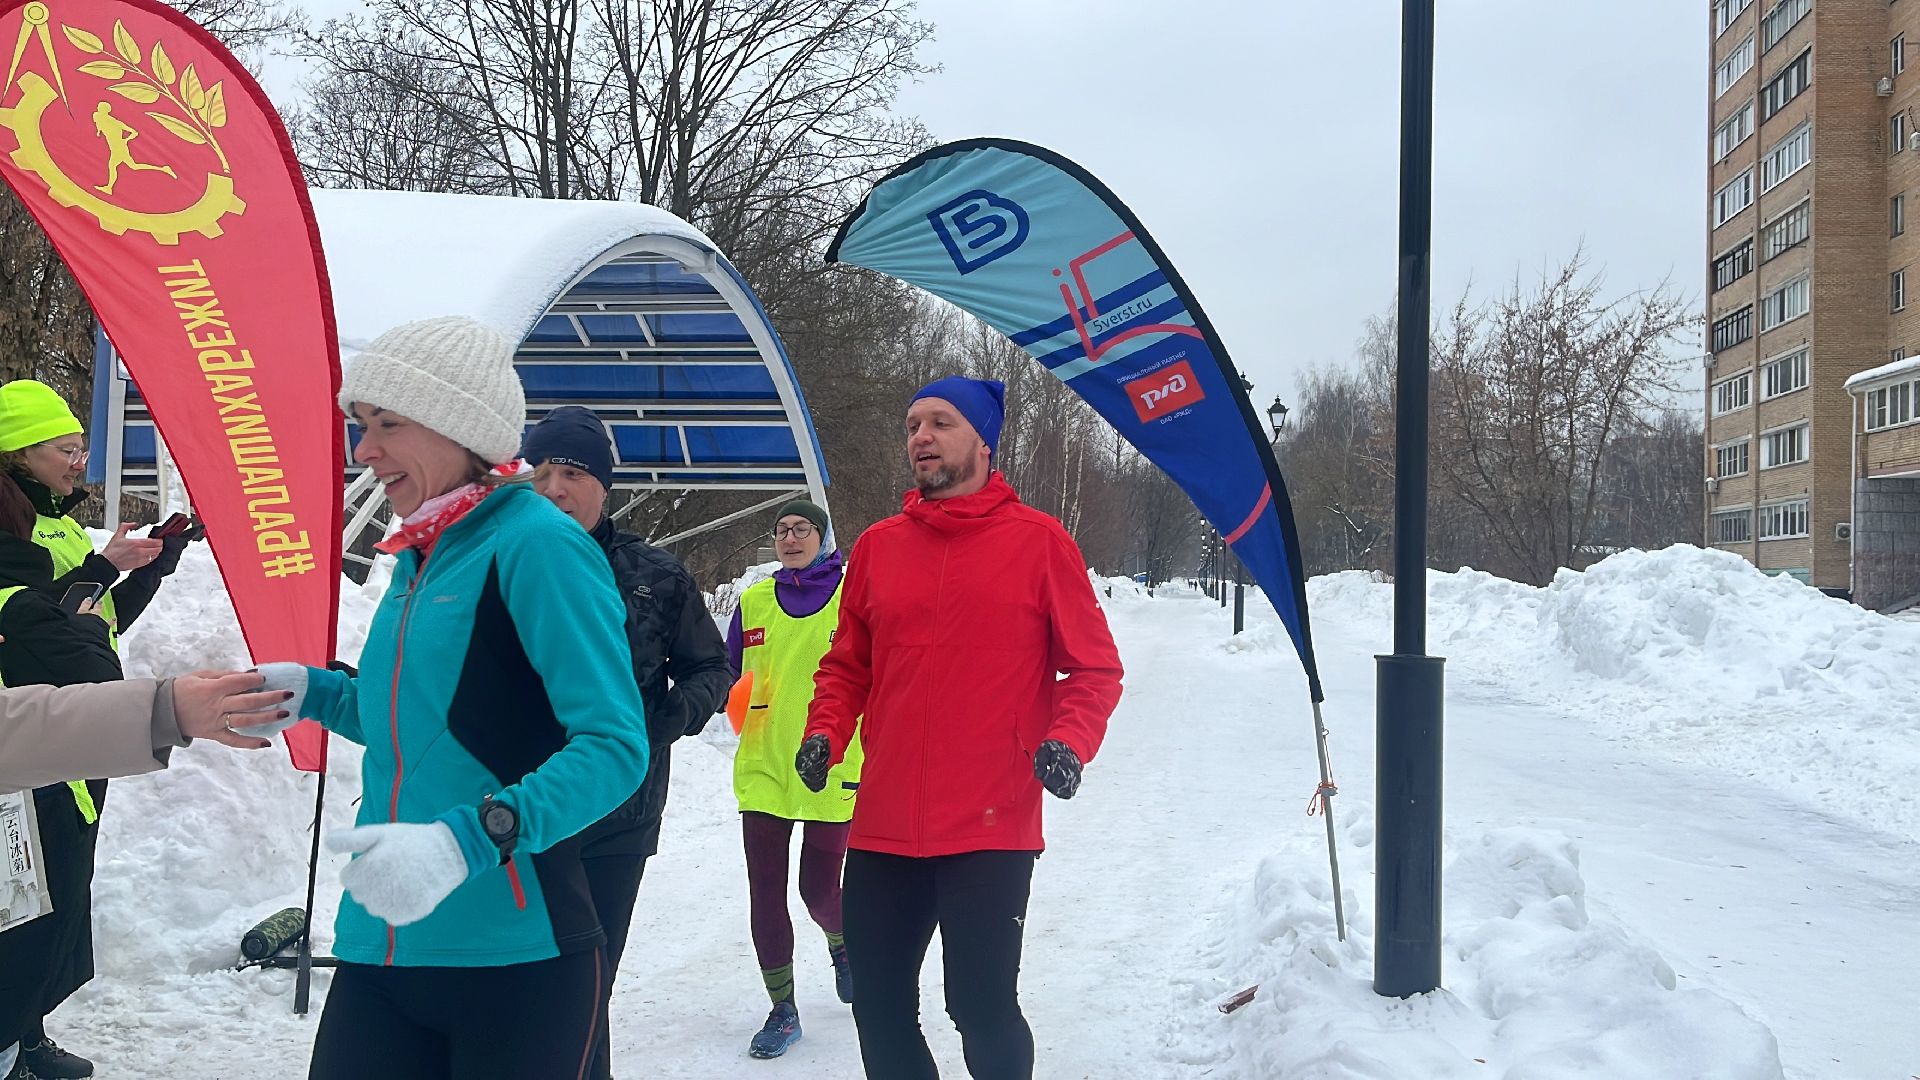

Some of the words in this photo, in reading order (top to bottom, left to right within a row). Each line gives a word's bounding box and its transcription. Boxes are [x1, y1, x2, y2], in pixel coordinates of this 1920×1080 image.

[1093, 297, 1153, 333] 5verst.ru
[1116, 362, 1161, 384] ОФИЦИАЛЬНЫЙ
[1160, 415, 1173, 425] ОАО
